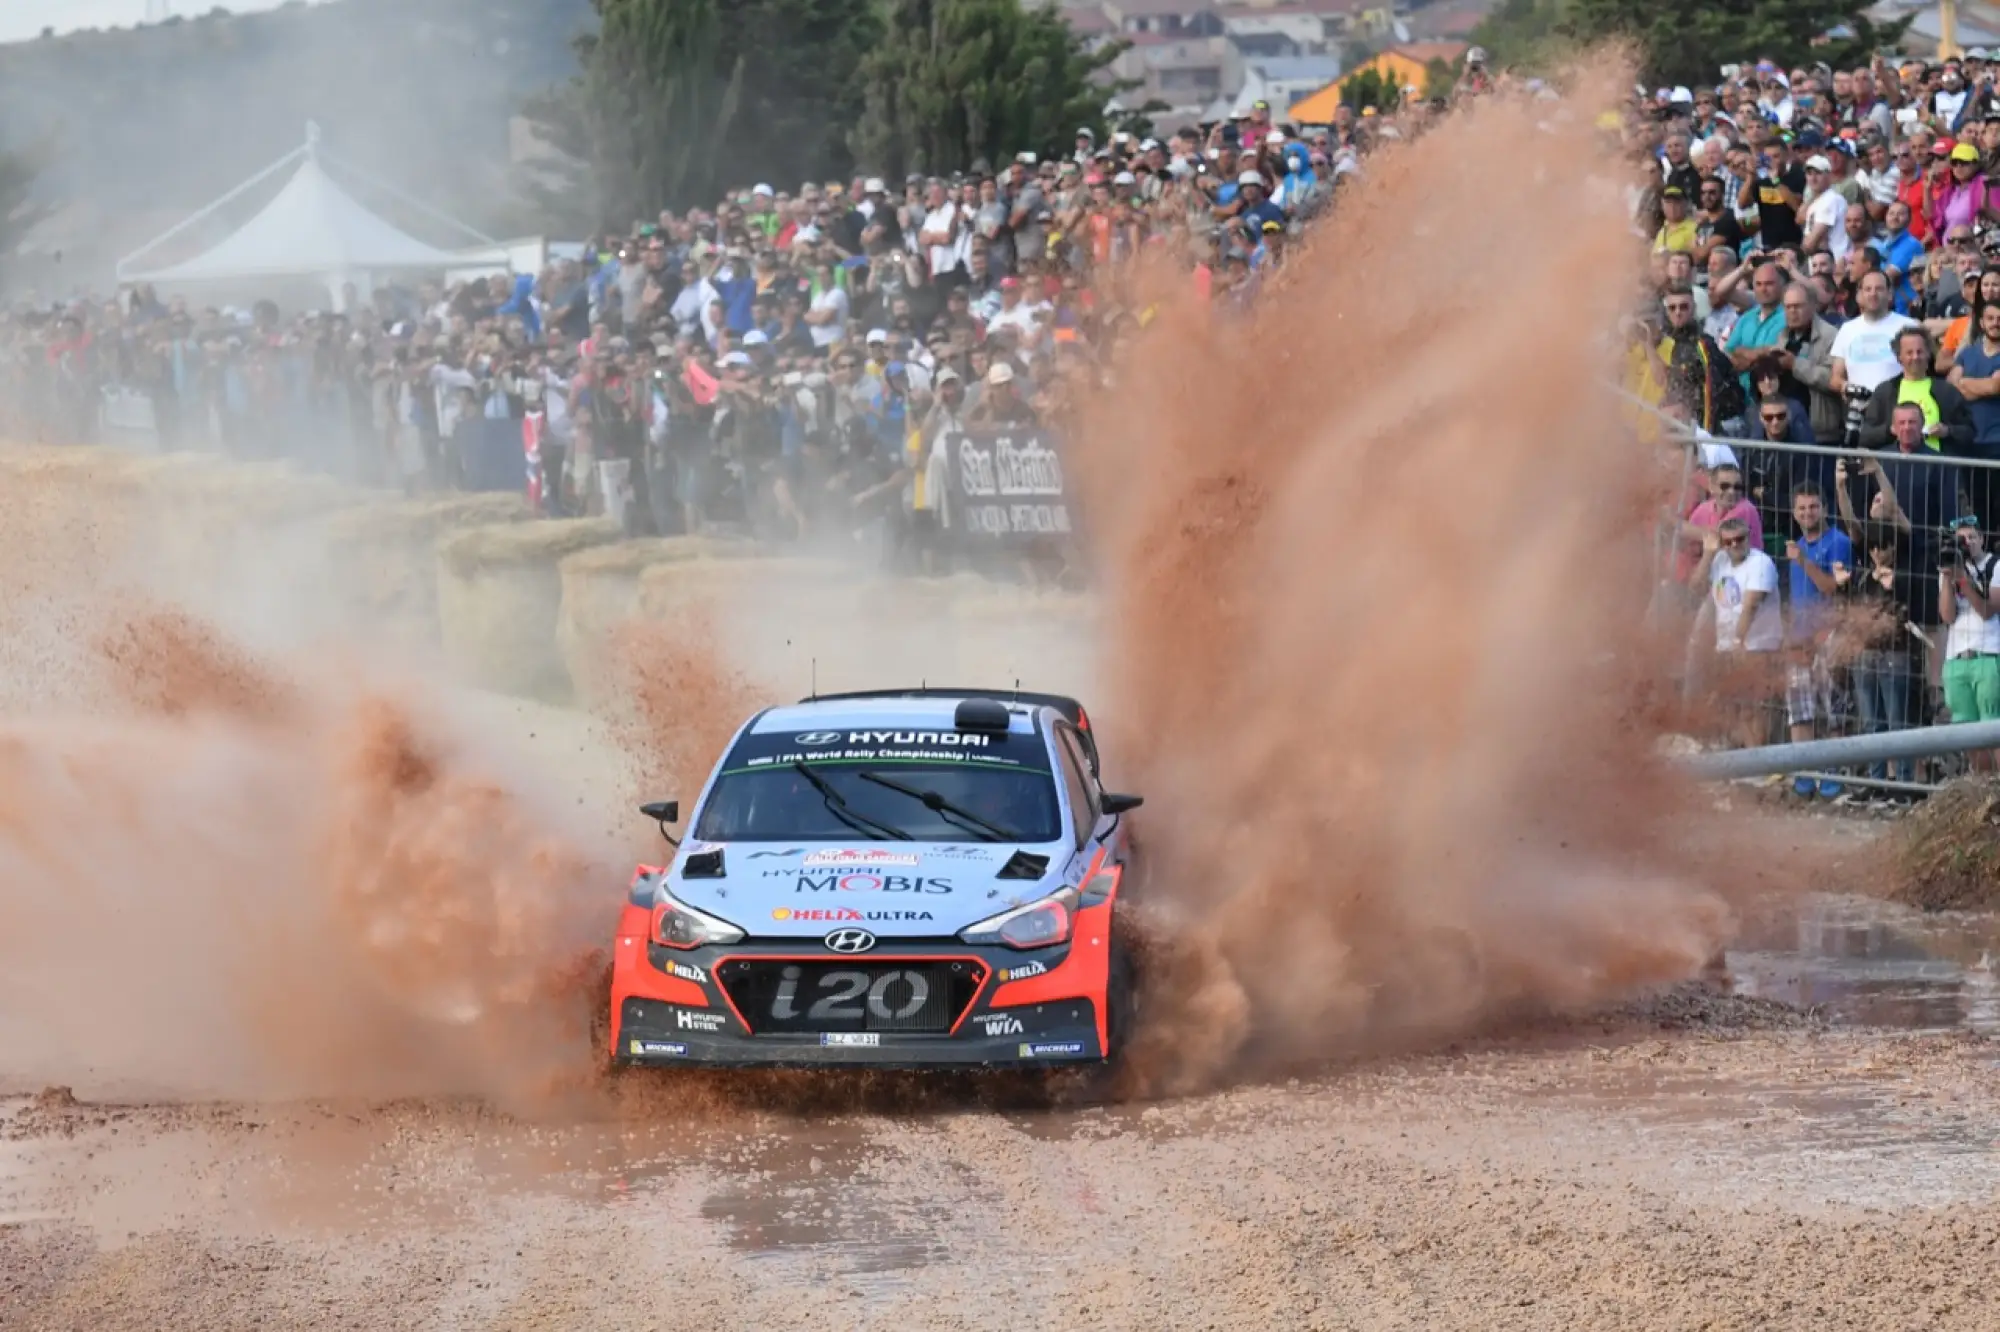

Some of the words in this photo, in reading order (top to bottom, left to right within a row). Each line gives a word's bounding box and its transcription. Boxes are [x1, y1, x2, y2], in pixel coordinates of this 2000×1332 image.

[849, 731, 989, 747] HYUNDAI
[806, 751, 841, 760] World
[844, 749, 876, 759] Rally
[879, 749, 964, 761] Championship
[762, 867, 881, 877] HYUNDAI
[795, 874, 953, 894] MOBIS
[793, 907, 863, 921] HELIX
[866, 911, 934, 921] ULTRA
[674, 963, 708, 983] HELIX
[1010, 960, 1047, 980] HELIX
[693, 1021, 719, 1032] STEEL
[645, 1043, 685, 1053] MICHELIN
[1035, 1044, 1080, 1053] MICHELIN
